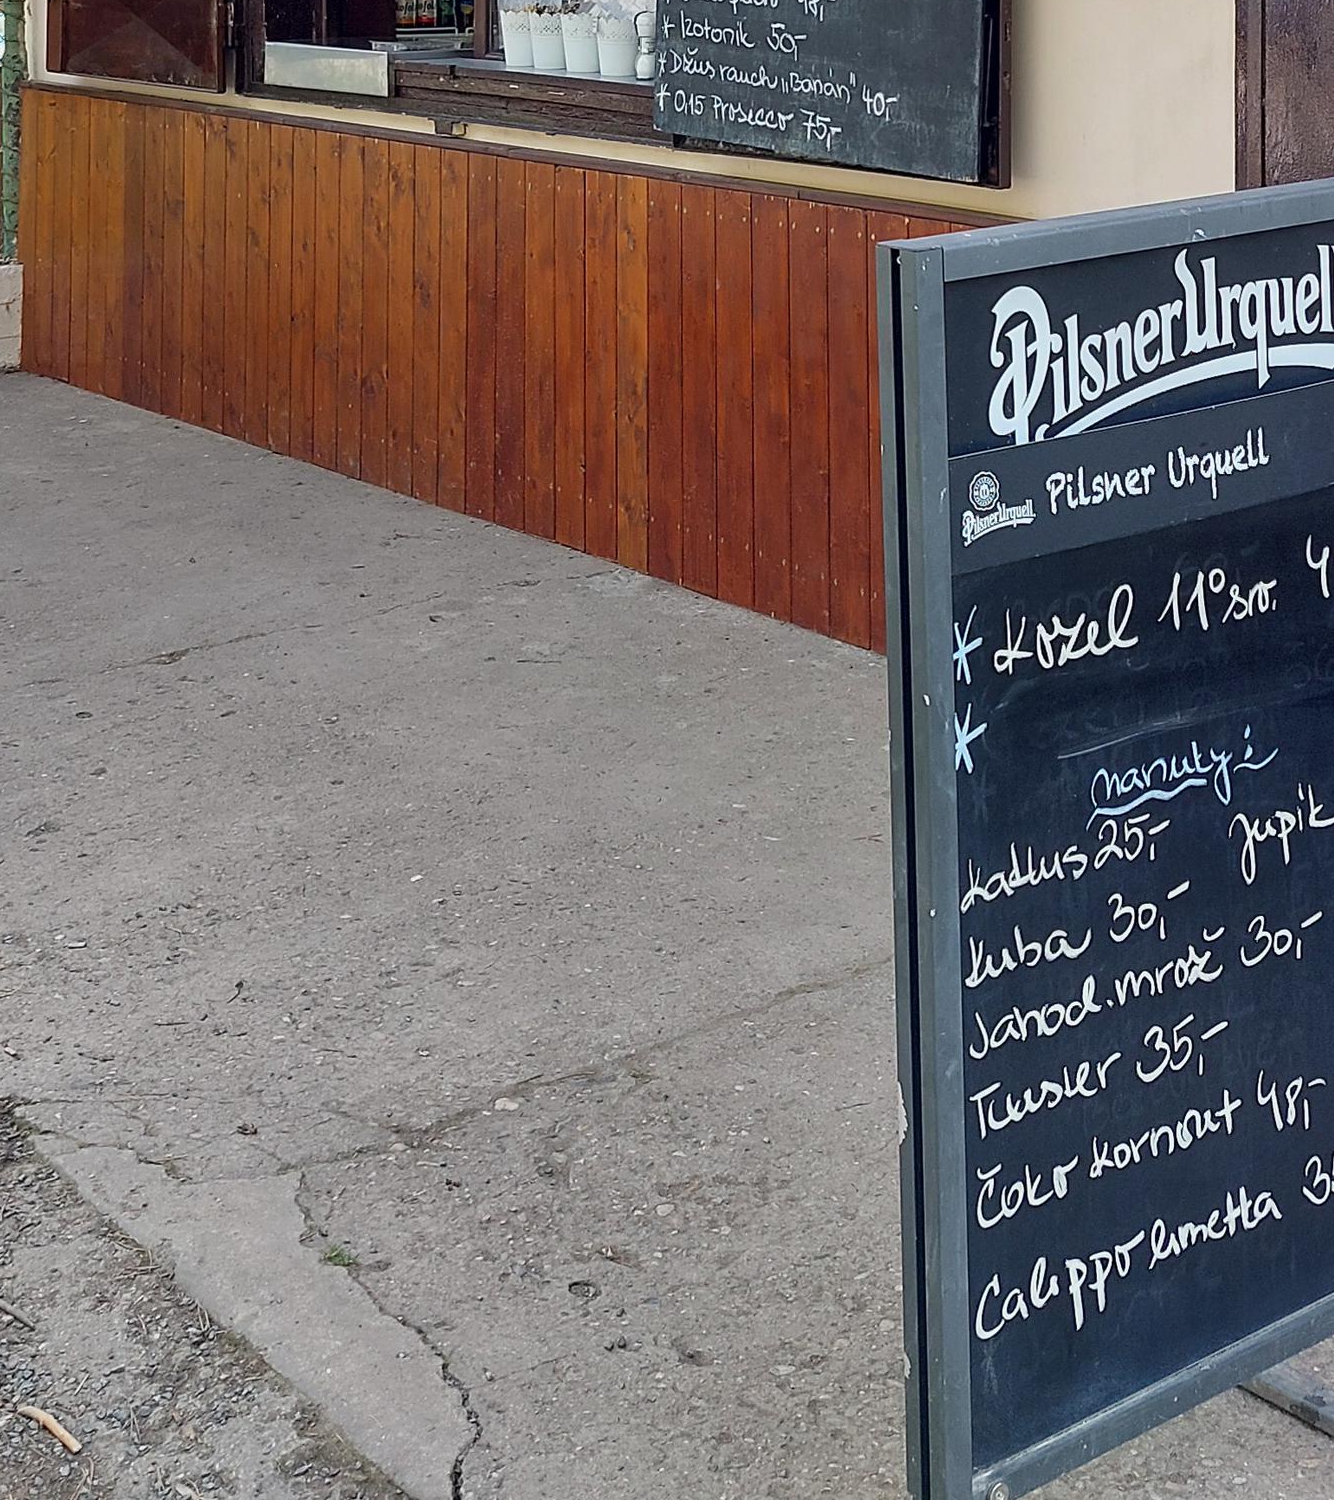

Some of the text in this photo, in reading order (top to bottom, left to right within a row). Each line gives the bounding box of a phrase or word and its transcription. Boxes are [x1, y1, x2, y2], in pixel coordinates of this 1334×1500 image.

[988, 285, 1183, 446] Pilsner
[1045, 427, 1270, 516] Pilsner Urquell
[961, 498, 1037, 548] Pilsner Urquell
[993, 583, 1139, 676] Kozel
